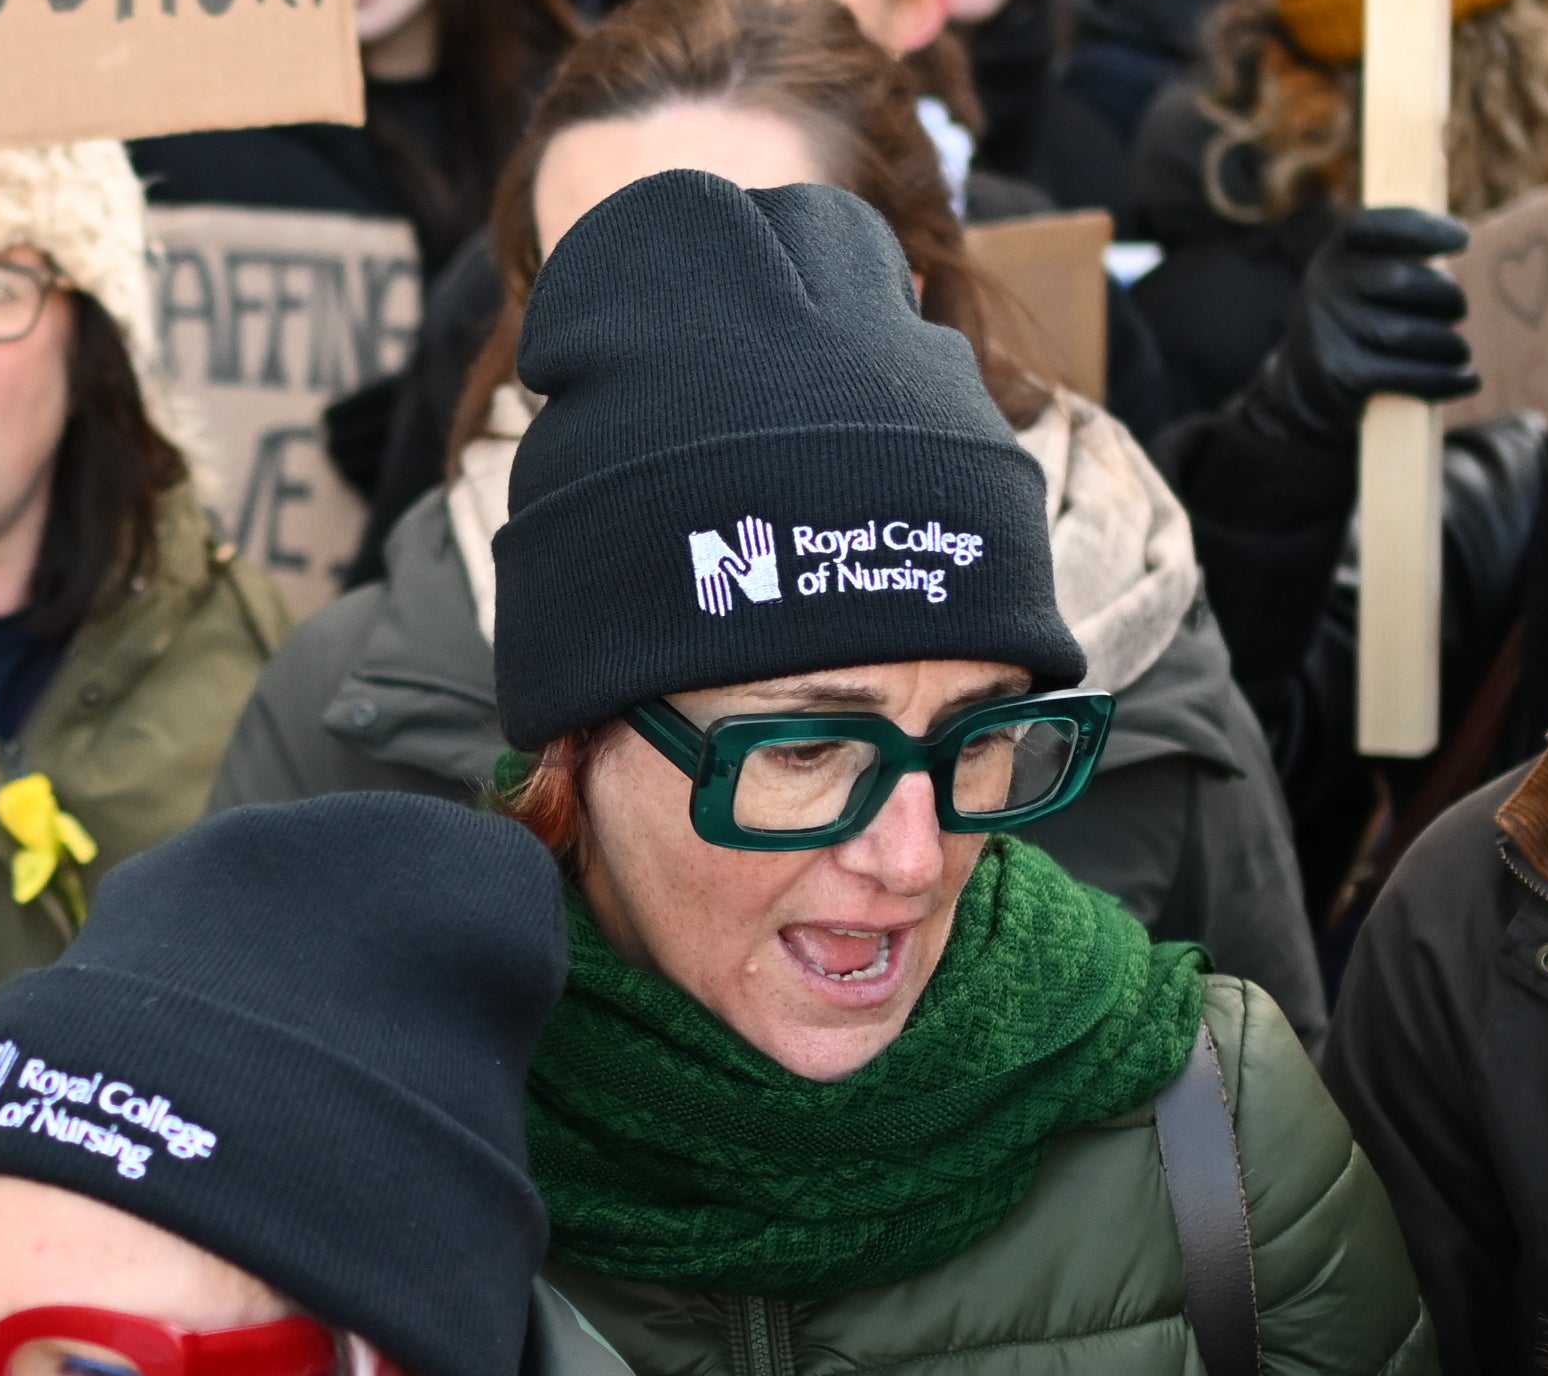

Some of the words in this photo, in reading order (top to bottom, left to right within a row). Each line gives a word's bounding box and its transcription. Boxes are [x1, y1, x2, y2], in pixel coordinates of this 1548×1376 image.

[792, 519, 877, 563] Royal
[882, 520, 984, 566] College
[797, 561, 831, 596] of
[836, 559, 948, 604] Nursing
[17, 1057, 104, 1106] Royal
[98, 1081, 217, 1159] College
[30, 1103, 154, 1180] Nursing
